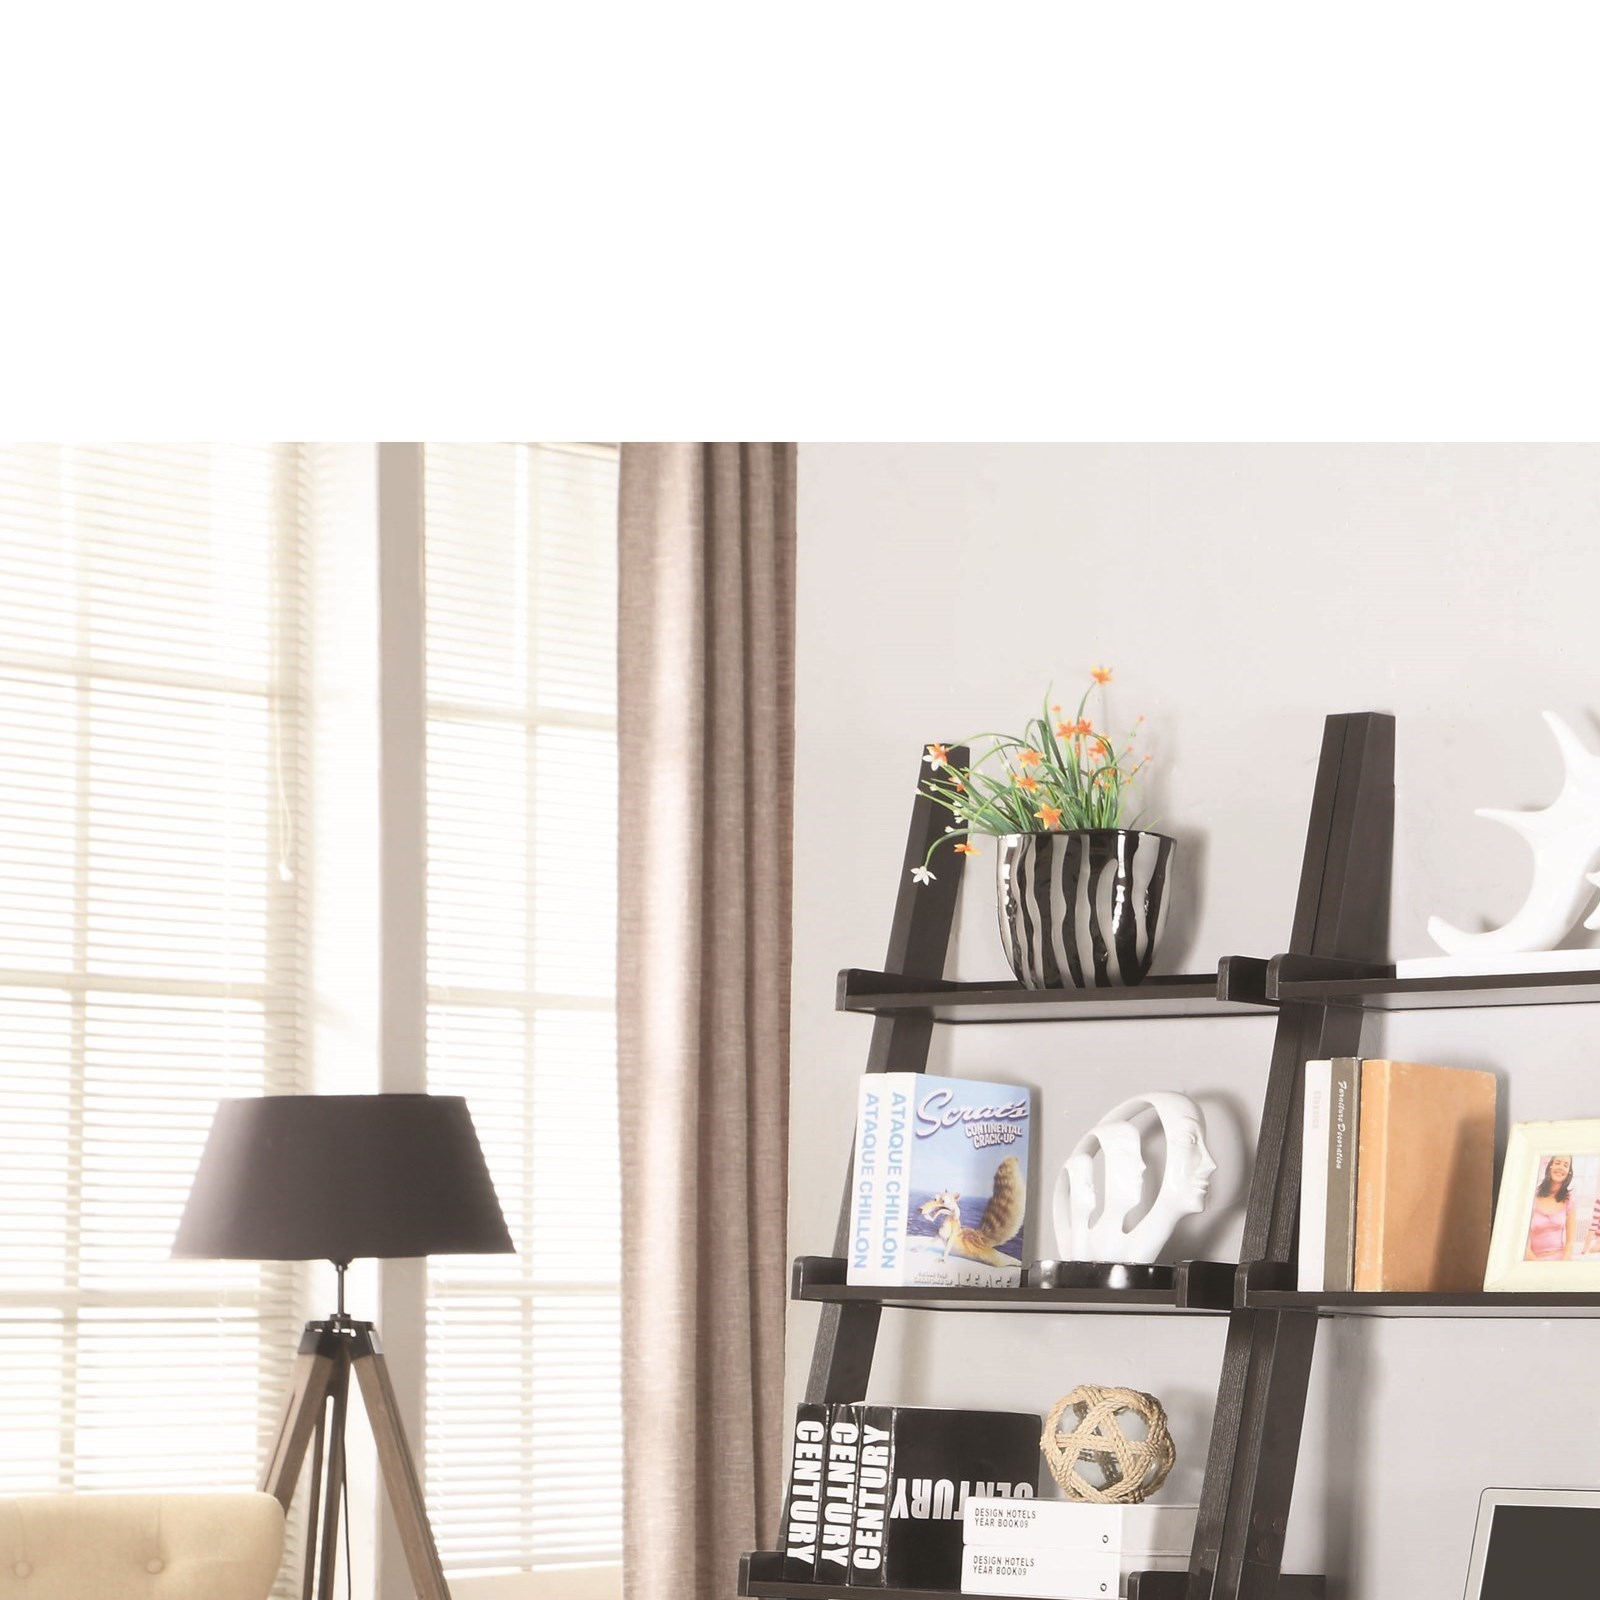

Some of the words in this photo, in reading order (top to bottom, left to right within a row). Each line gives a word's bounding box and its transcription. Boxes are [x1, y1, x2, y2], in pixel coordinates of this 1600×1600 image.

[861, 1092, 879, 1176] ATAQUE
[888, 1091, 907, 1176] ATAQUE
[916, 1087, 1029, 1138] Scrat's
[964, 1121, 1022, 1137] CONTINENTAL
[853, 1180, 873, 1269] CHILLON
[881, 1180, 900, 1269] CHILLON
[787, 1421, 825, 1565] CENTURY
[821, 1422, 859, 1567] CENTURY
[853, 1424, 890, 1570] CENTURY
[975, 1508, 1003, 1518] DESIGN
[1006, 1509, 1036, 1520] HOTELS
[975, 1518, 995, 1527] YEAR
[973, 1555, 1002, 1565] DESIGN
[1005, 1557, 1035, 1567] HOTELS
[973, 1565, 993, 1575] YEAR
